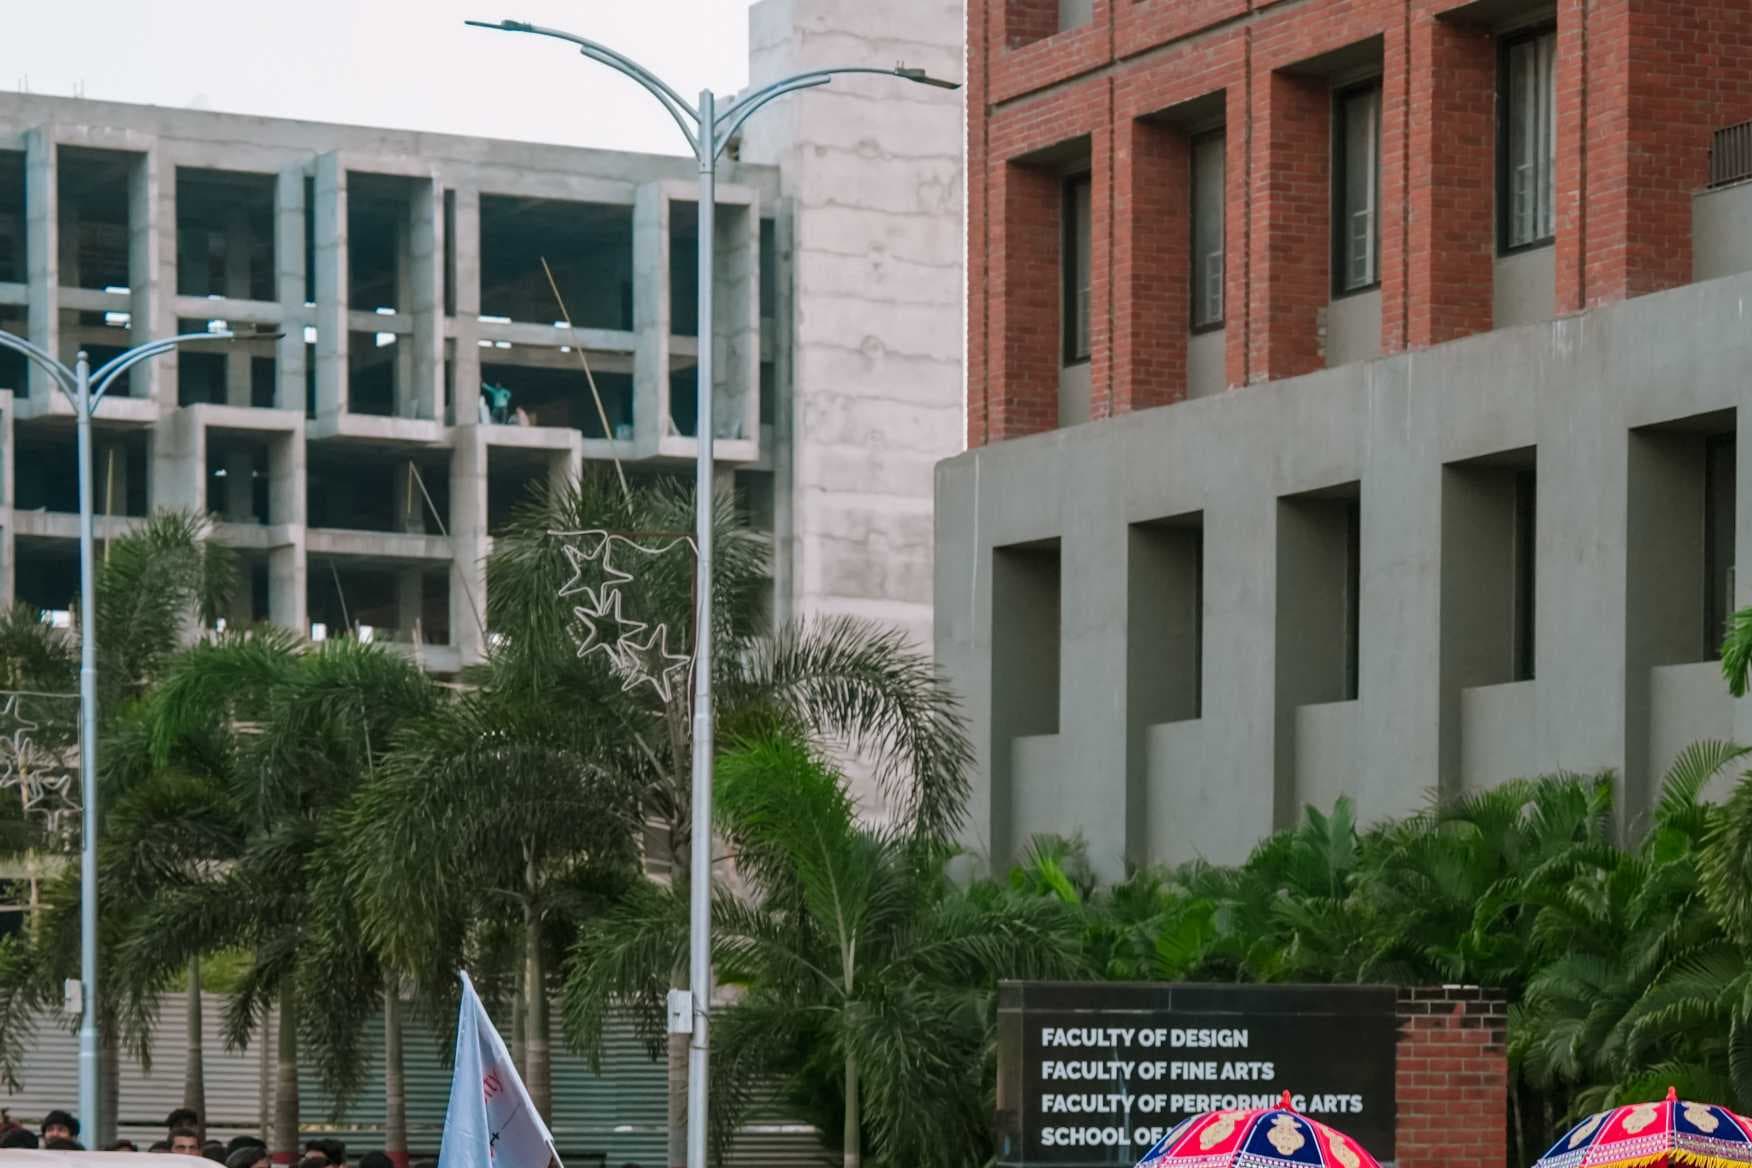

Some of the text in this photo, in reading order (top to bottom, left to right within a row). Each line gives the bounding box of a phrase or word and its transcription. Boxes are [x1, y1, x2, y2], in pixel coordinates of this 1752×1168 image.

[1041, 1028, 1249, 1048] FACULTY OF DESIGN
[1041, 1061, 1275, 1080] FACULTY OF FINE ARTS
[1041, 1094, 1135, 1113] FACULTY
[1138, 1094, 1167, 1113] OF
[1309, 1094, 1363, 1113] ARTS
[1041, 1126, 1131, 1146] SCHOOL
[1134, 1127, 1163, 1146] OF
